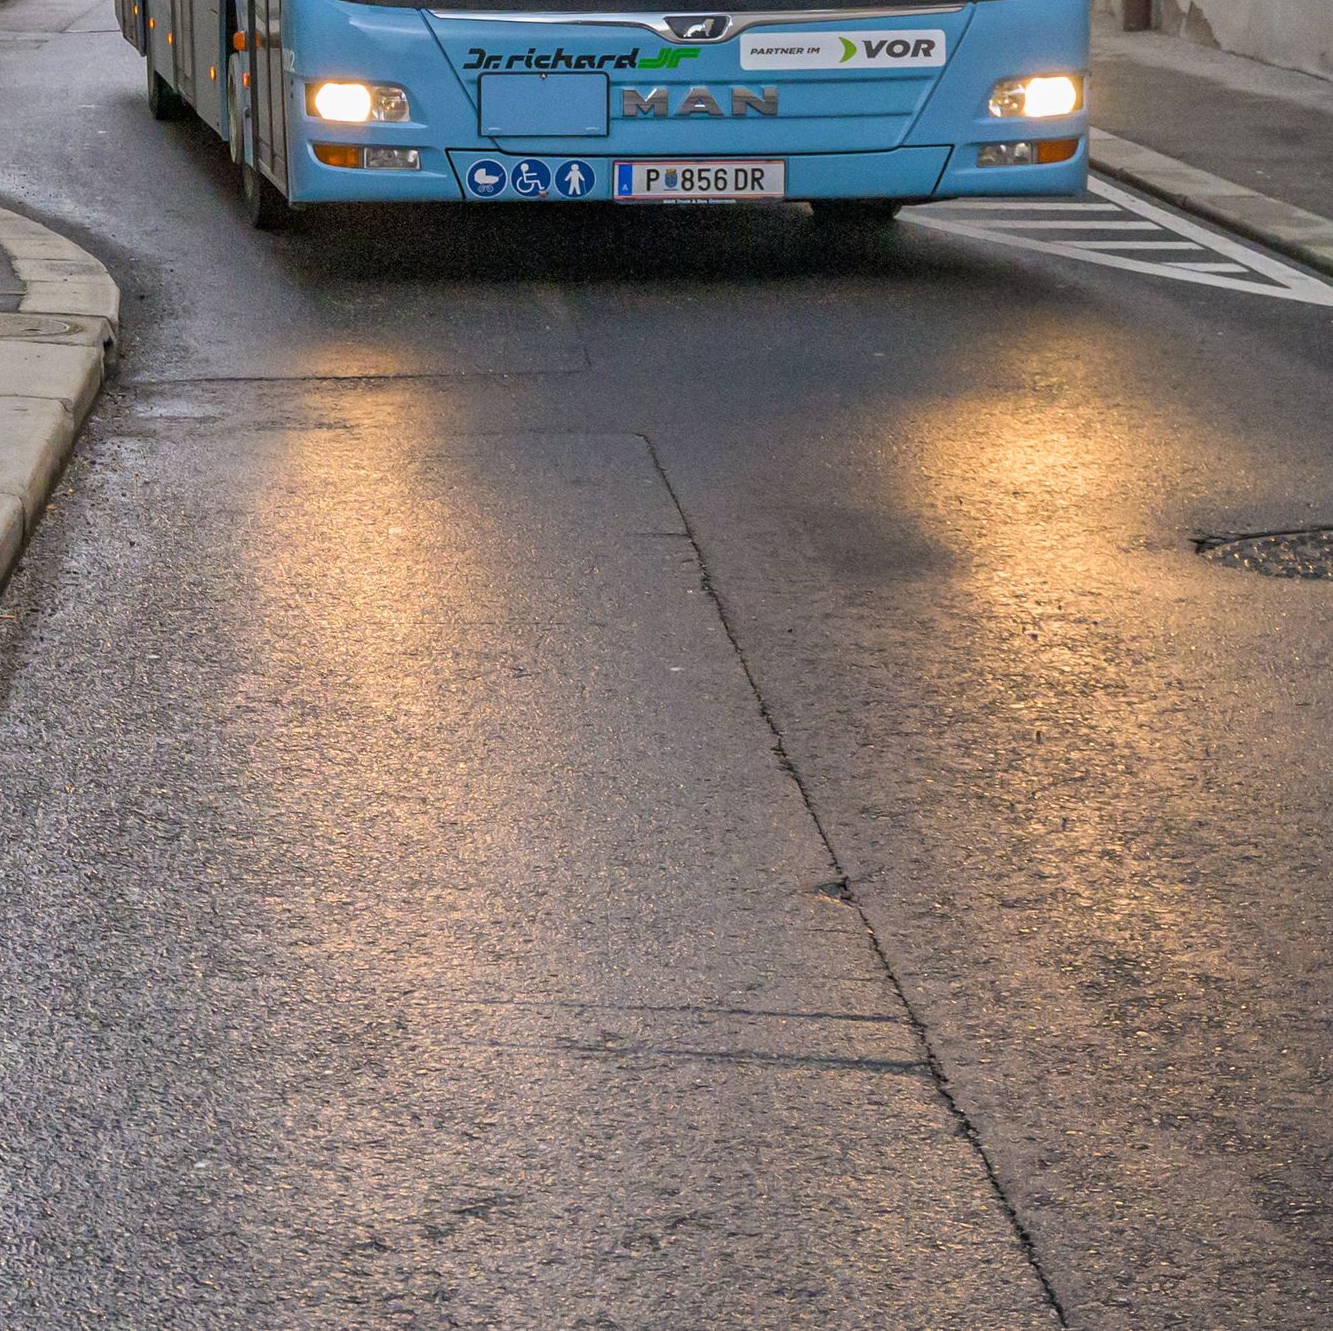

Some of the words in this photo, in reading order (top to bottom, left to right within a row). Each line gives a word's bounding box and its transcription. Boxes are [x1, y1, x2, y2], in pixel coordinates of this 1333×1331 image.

[749, 47, 805, 56] PARTNER
[807, 46, 821, 55] IM
[862, 39, 937, 59] VOR
[623, 86, 780, 118] MAN
[645, 168, 661, 192] P
